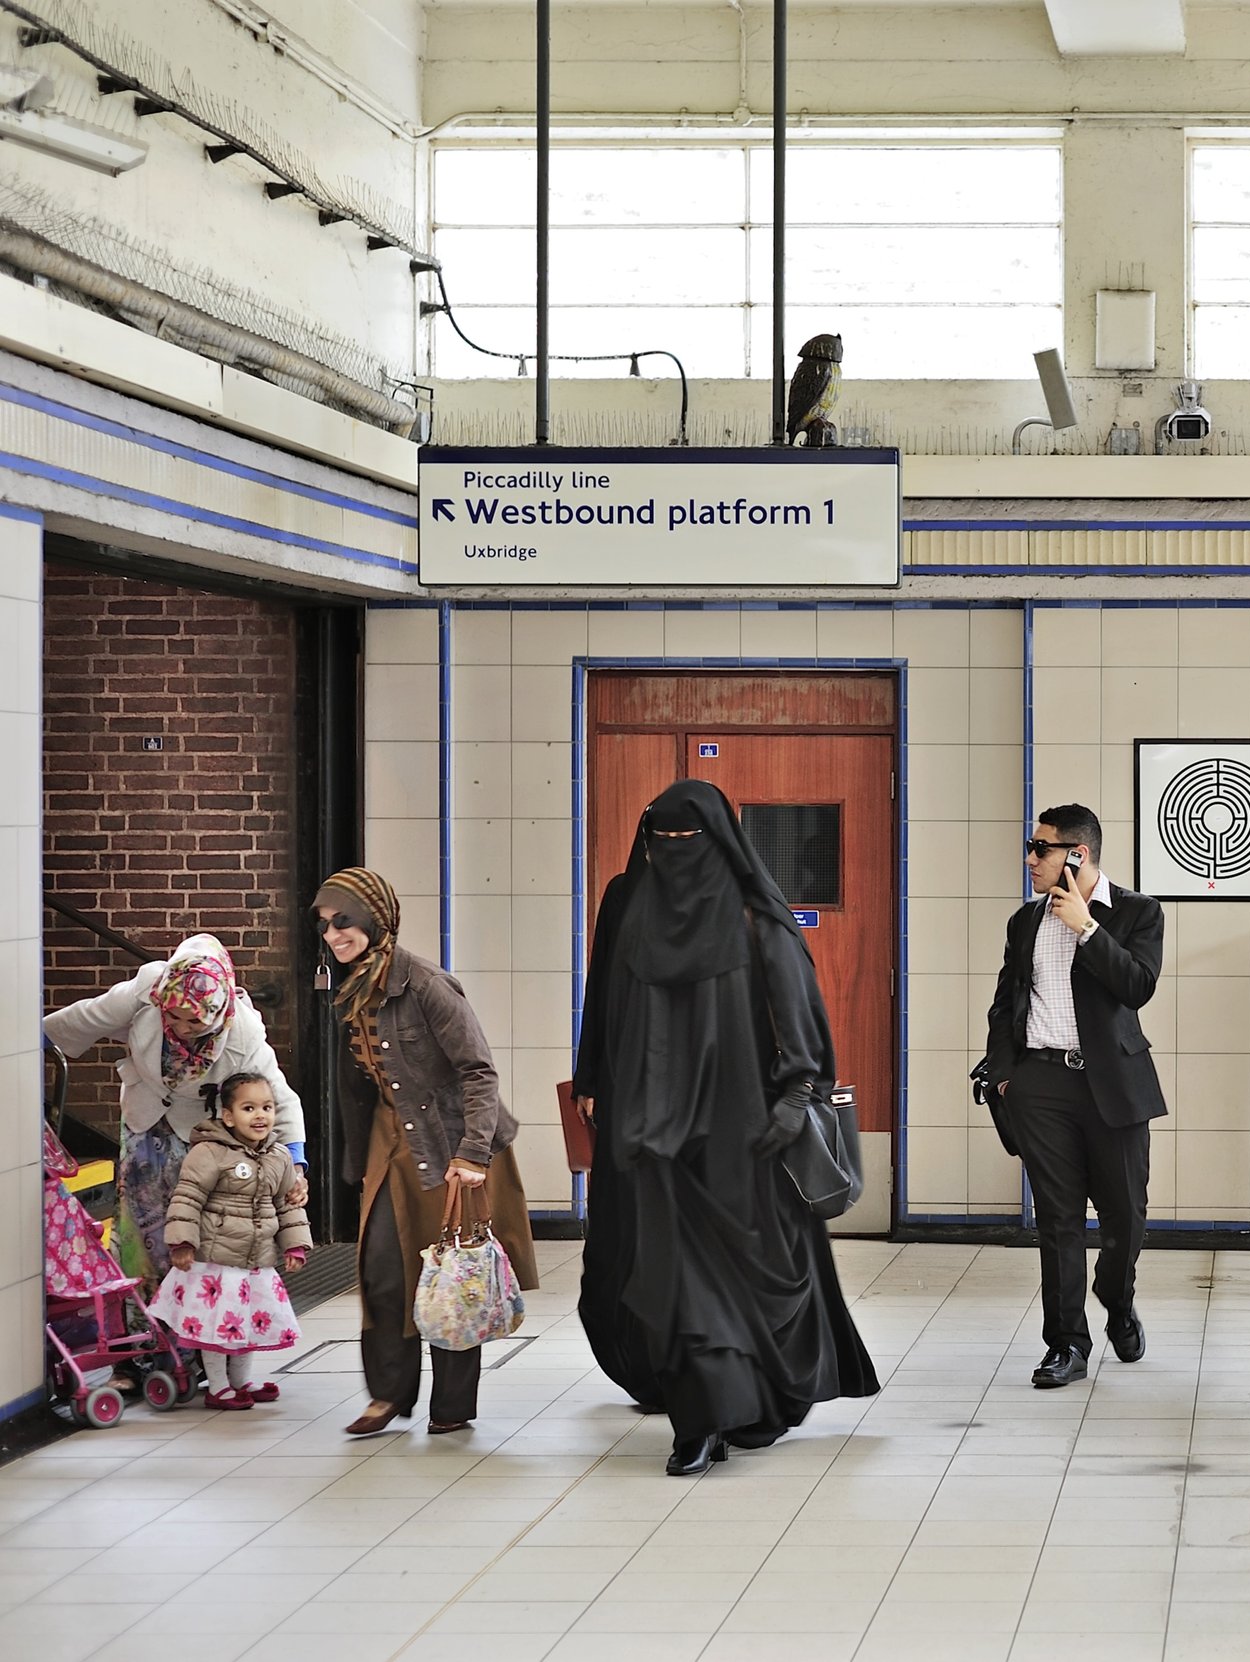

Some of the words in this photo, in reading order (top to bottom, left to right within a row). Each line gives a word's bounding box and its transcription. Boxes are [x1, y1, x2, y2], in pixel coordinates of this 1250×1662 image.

[463, 471, 563, 491] Piccadilly
[572, 470, 610, 489] line
[465, 498, 656, 525] Westbound
[668, 498, 812, 530] platform
[823, 499, 835, 525] 1
[464, 544, 537, 559] Uxbridge
